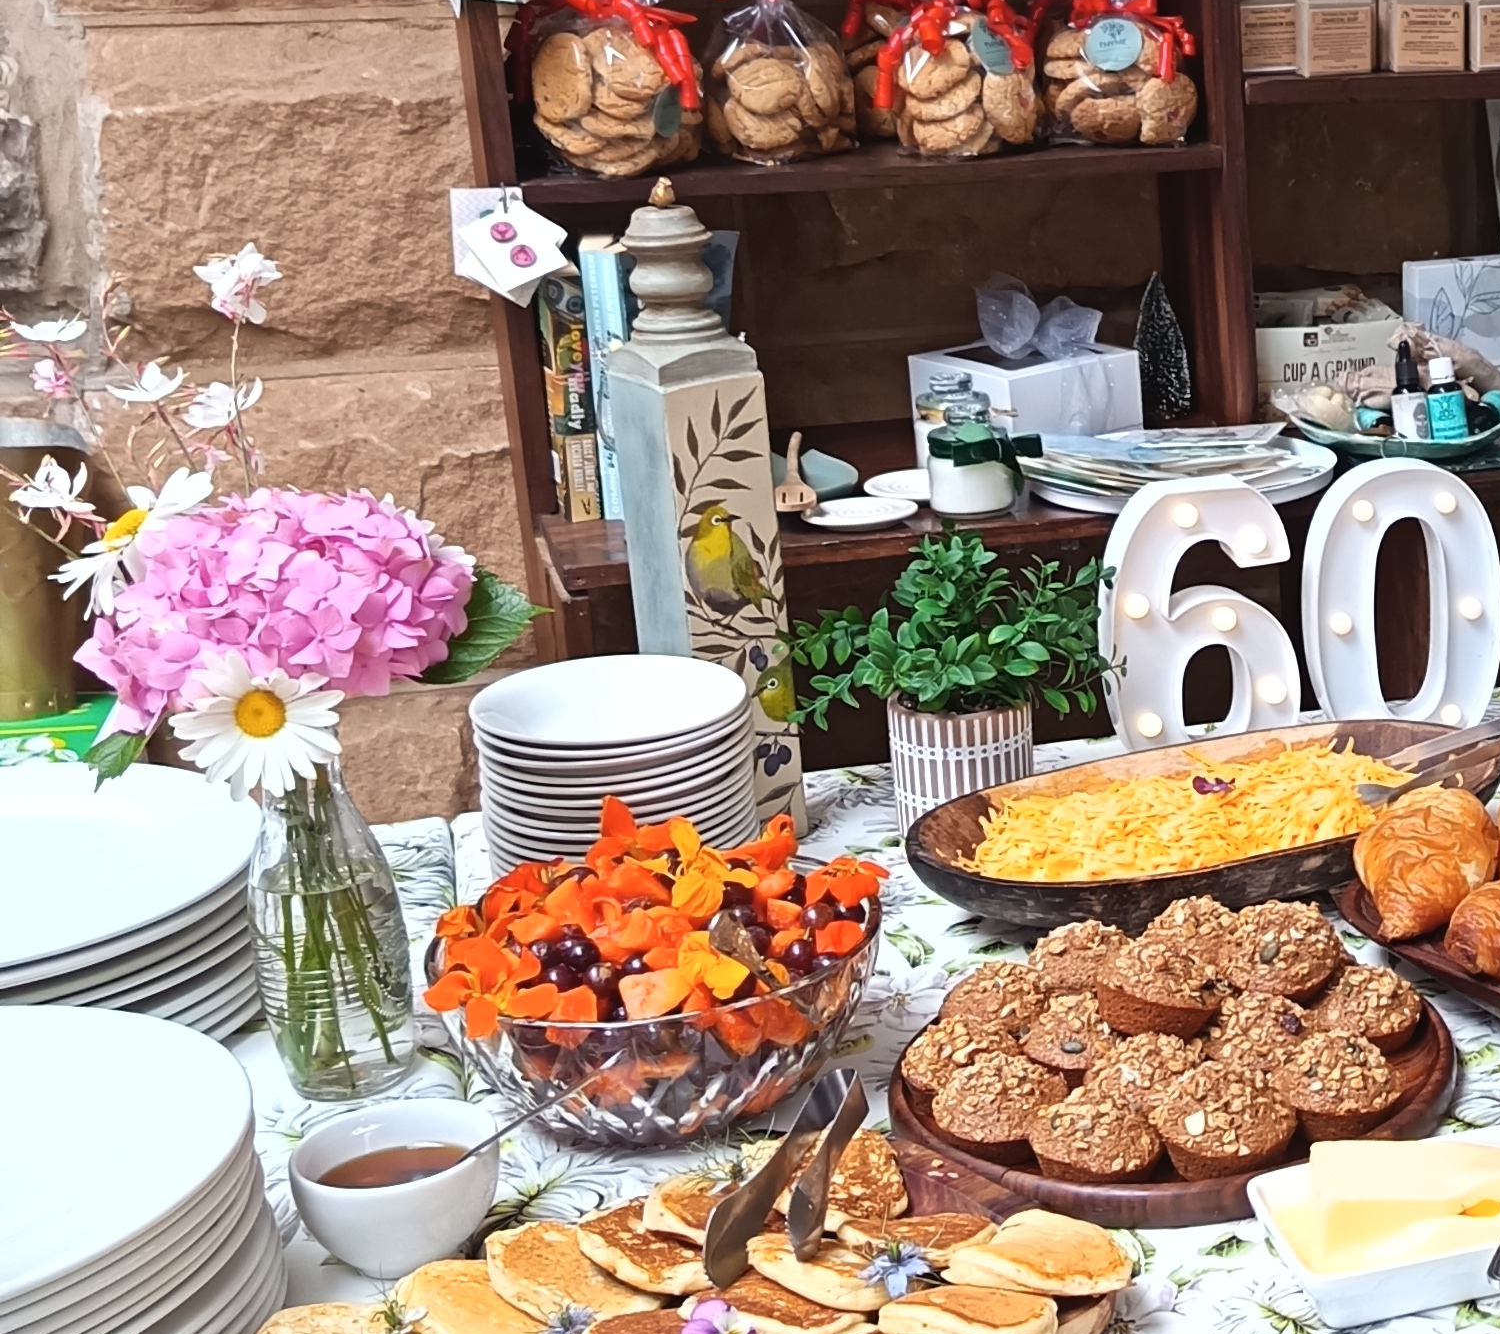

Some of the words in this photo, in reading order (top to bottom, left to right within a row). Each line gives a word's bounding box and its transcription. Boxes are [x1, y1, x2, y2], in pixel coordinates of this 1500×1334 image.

[570, 323, 585, 363] love
[570, 363, 586, 394] you
[1283, 363, 1307, 383] CUP
[1311, 361, 1321, 382] A
[567, 376, 586, 431] madly
[608, 467, 621, 514] COMING
